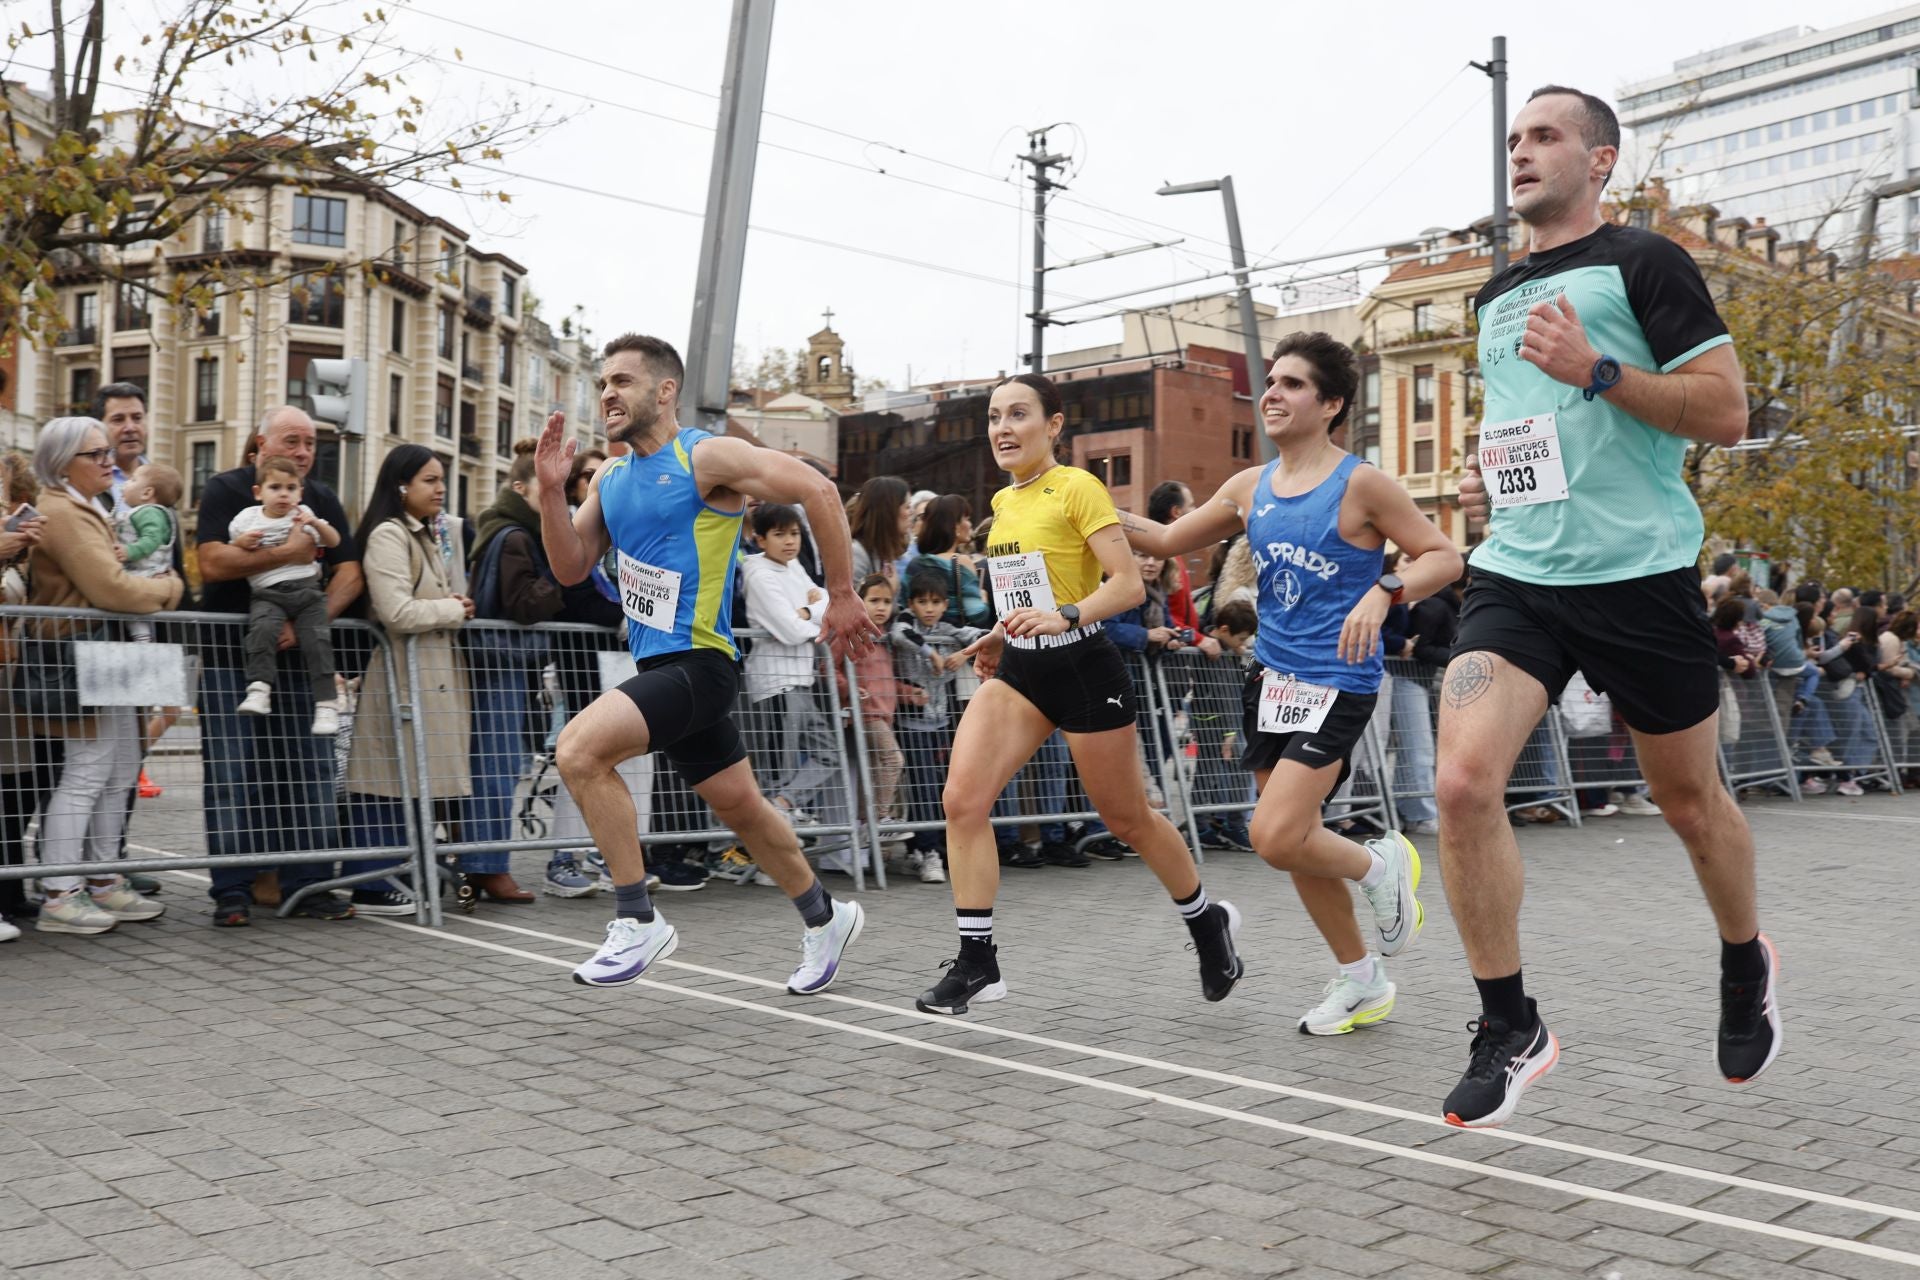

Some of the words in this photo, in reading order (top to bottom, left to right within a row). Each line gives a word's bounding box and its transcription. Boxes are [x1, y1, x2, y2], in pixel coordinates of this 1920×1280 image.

[1507, 440, 1548, 454] SANTURCE
[1481, 448, 1507, 467] XXXVI
[1509, 449, 1549, 464] BILBAO
[1497, 465, 1537, 495] 2333
[1266, 541, 1340, 581] PRADO
[1012, 571, 1039, 580] SANTURCE
[1013, 577, 1041, 588] BILBAO
[639, 586, 670, 600] BILBAO
[640, 580, 671, 594] SANTURCE
[626, 589, 655, 617] 2766
[1004, 589, 1033, 611] 1138
[1265, 687, 1295, 703] XXXVI
